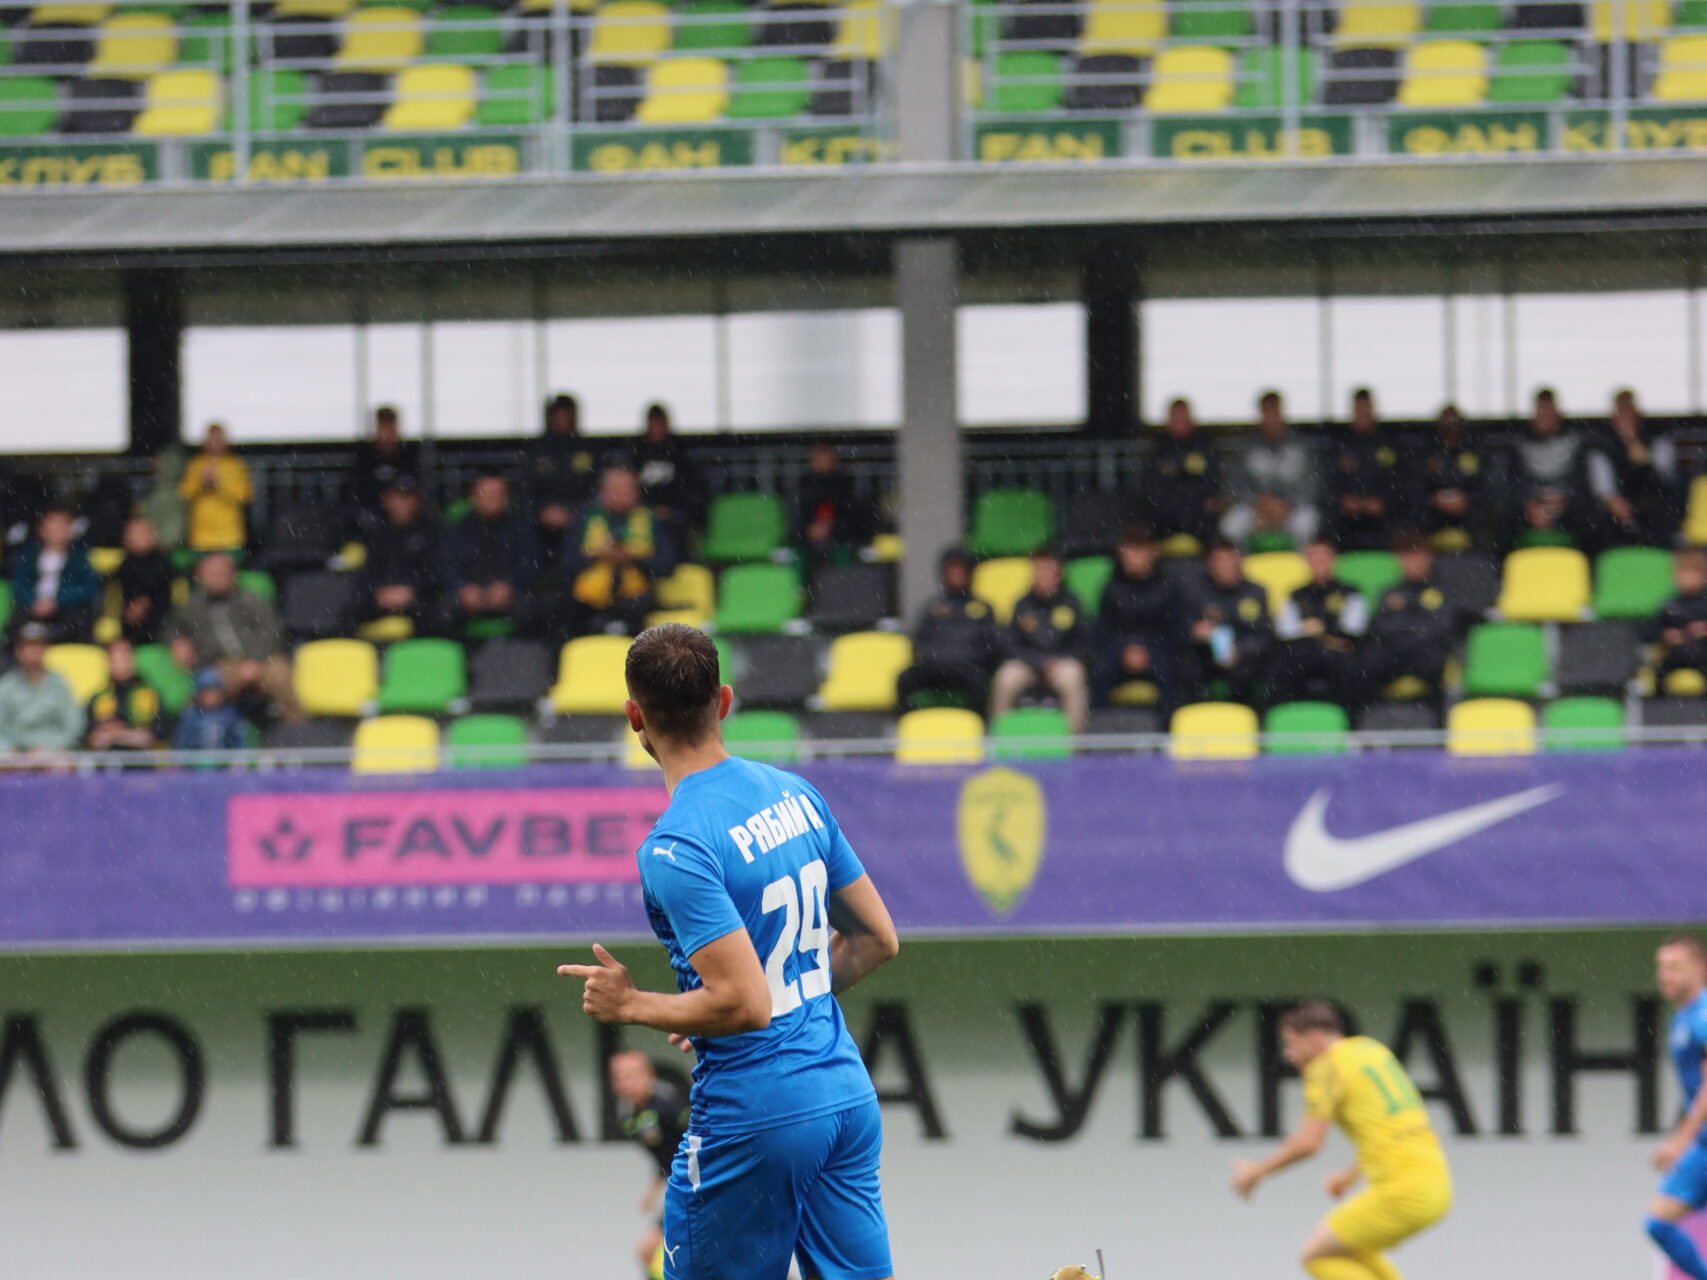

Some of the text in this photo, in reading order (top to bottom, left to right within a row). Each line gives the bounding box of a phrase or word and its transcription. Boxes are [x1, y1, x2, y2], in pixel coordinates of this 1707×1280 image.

[208, 144, 520, 184] FAN CLUB
[979, 127, 1334, 163] FAN CLUB
[728, 789, 810, 864] РЯБИЙ
[761, 858, 832, 1018] 29
